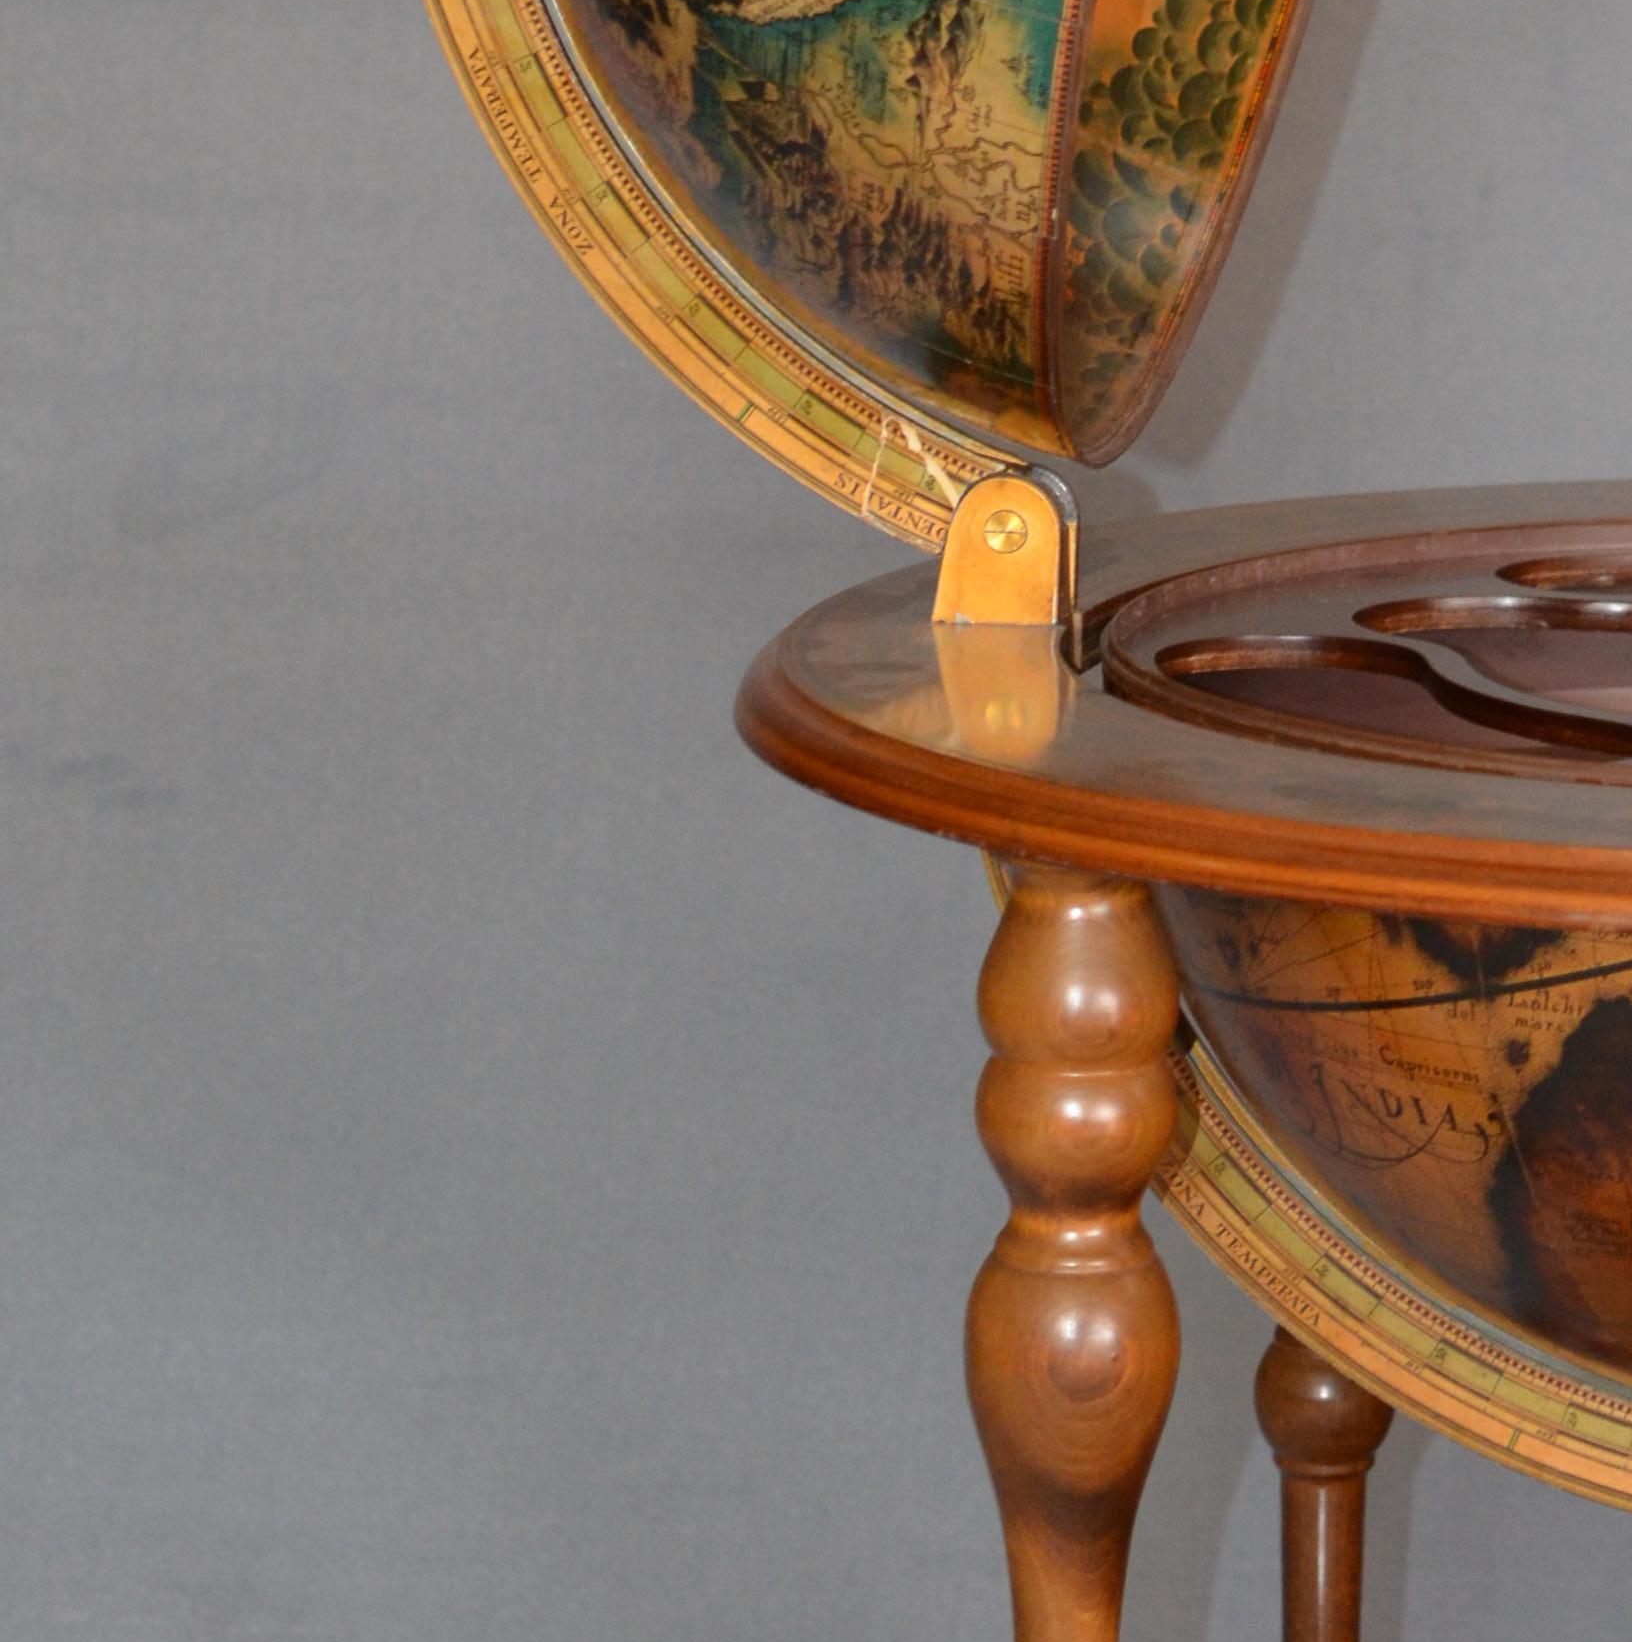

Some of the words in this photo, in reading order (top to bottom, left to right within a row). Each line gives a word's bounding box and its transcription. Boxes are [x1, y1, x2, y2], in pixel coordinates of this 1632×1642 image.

[467, 47, 543, 183] TEMPERATA
[549, 196, 594, 256] ZONA
[1215, 1221, 1322, 1326] TEMPERATA
